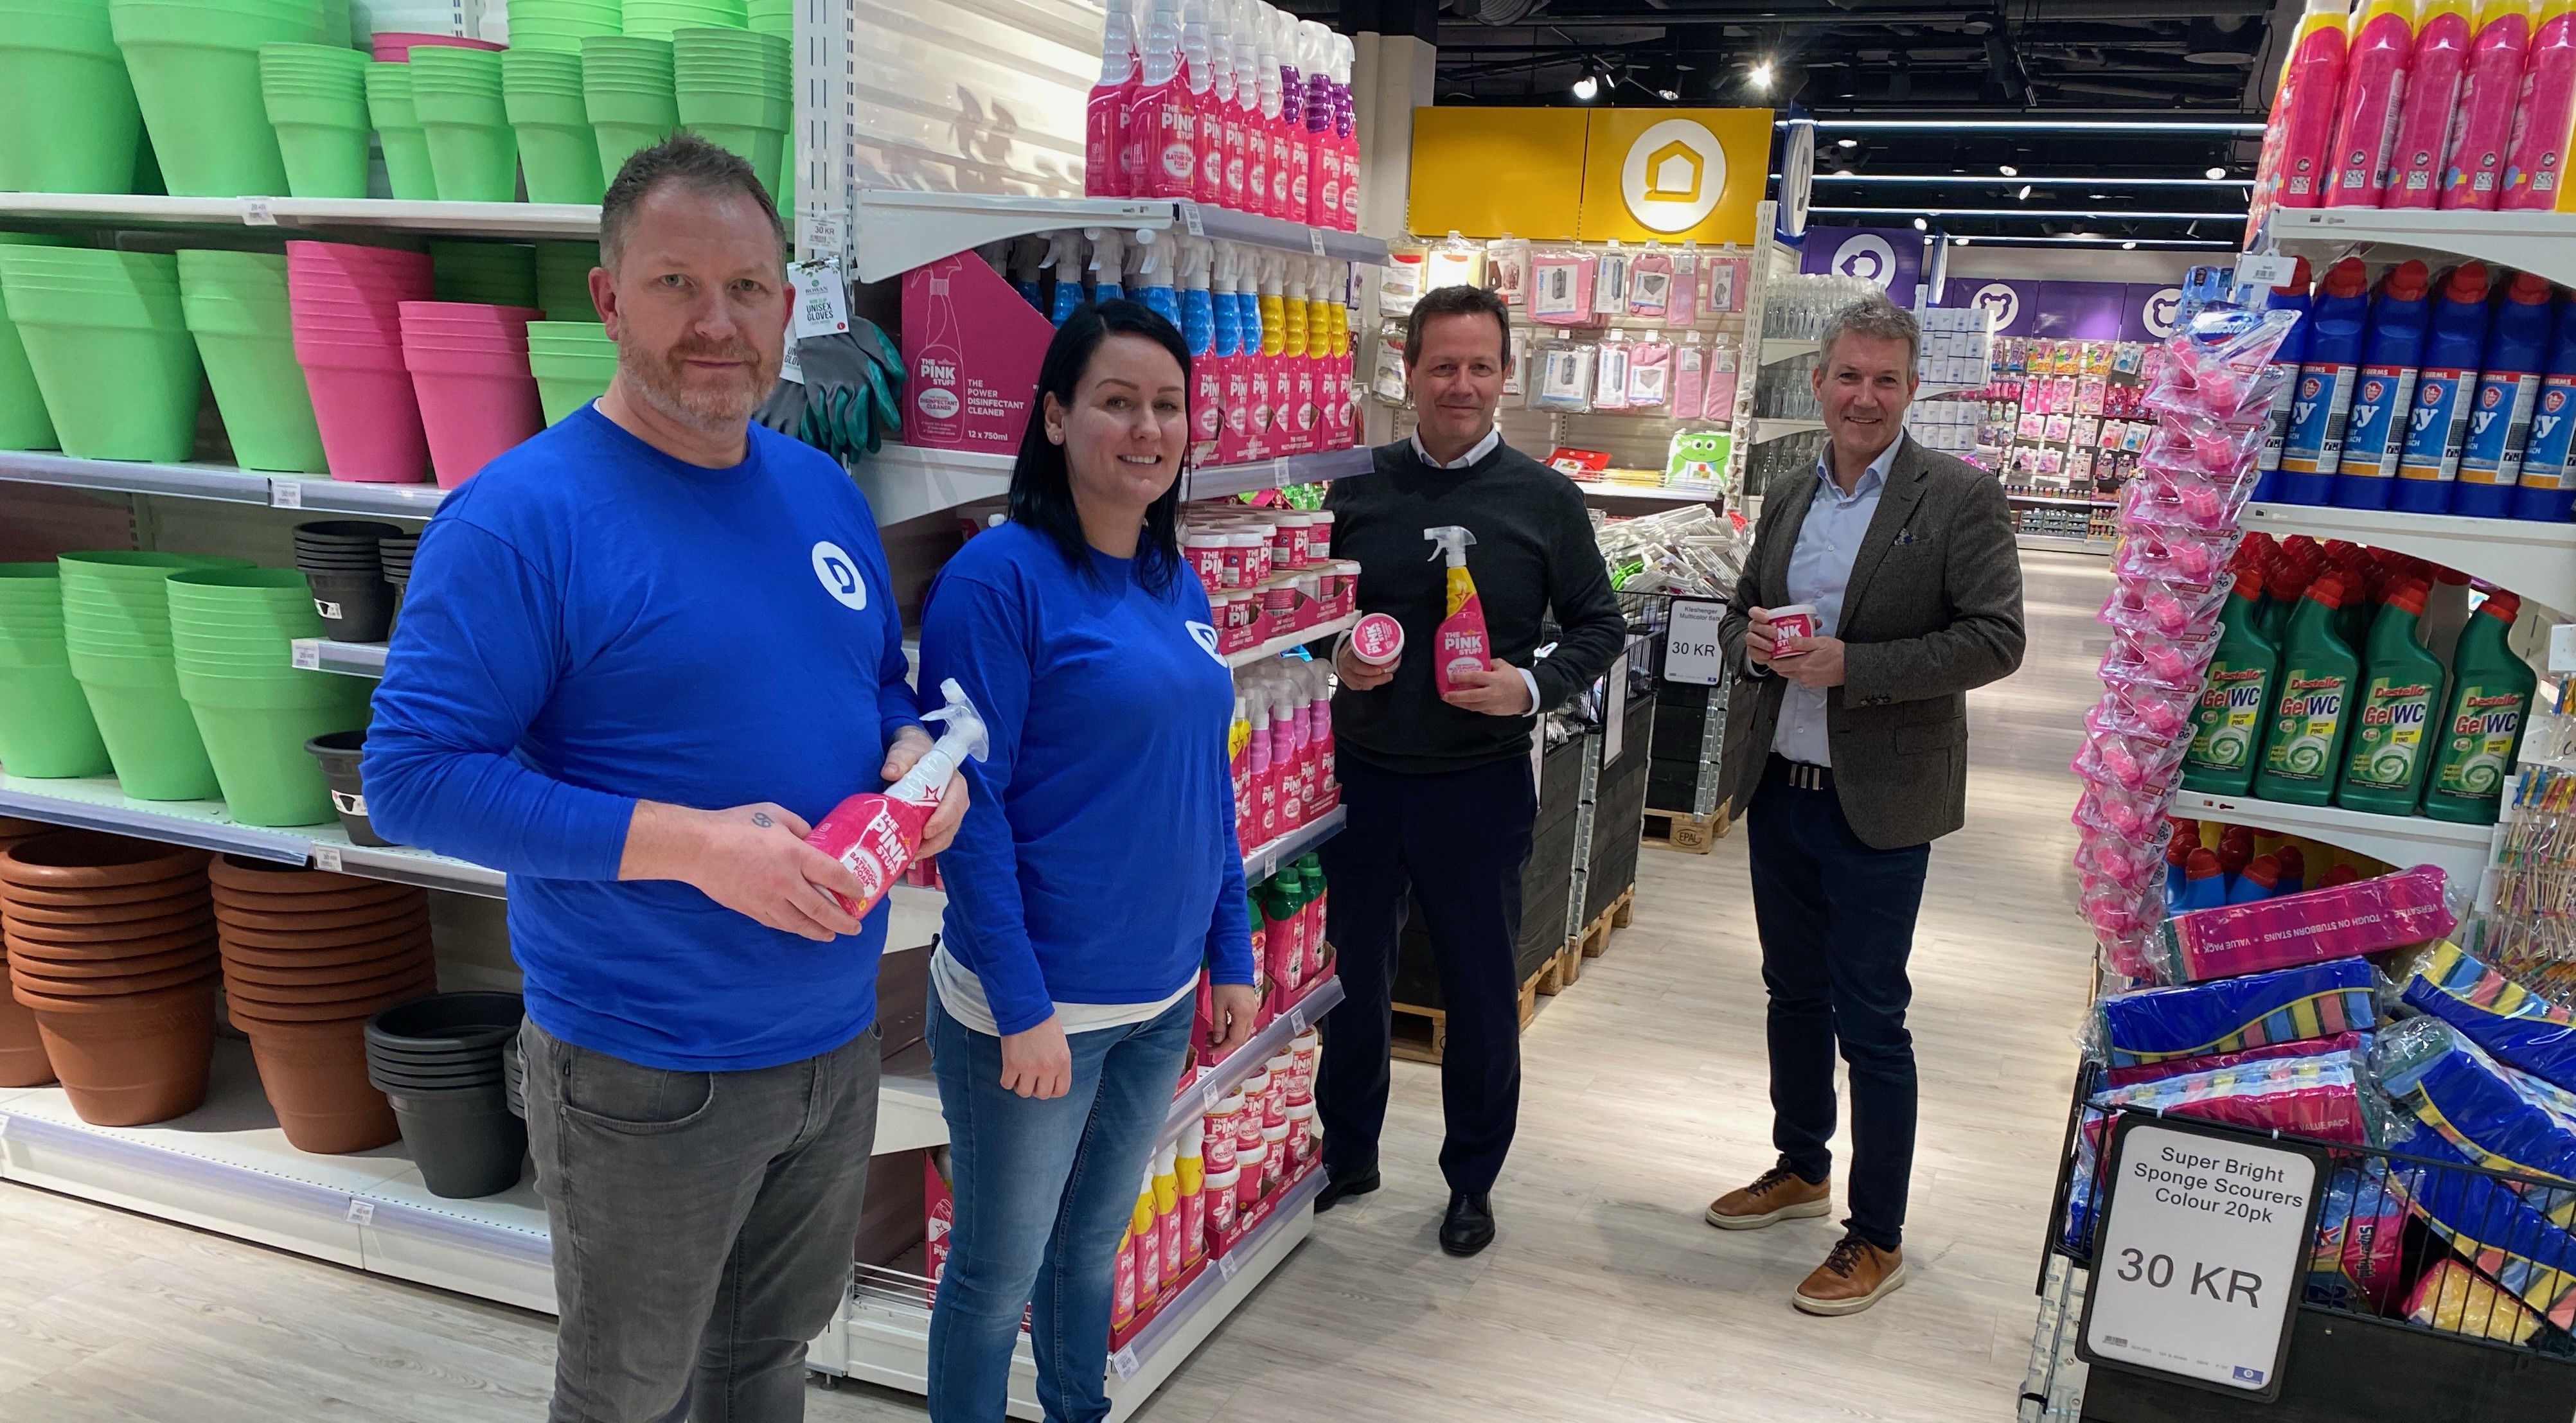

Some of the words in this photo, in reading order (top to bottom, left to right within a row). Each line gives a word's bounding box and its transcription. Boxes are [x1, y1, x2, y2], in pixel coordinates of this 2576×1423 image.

[1162, 103, 1180, 113] THE
[1162, 112, 1195, 132] PINK
[1204, 121, 1221, 139] PIN
[1226, 129, 1244, 146] PIN
[1250, 136, 1265, 154] PIN
[1273, 144, 1288, 160] PIN
[1292, 149, 1308, 168] PIN
[1323, 155, 1340, 172] PIN
[1343, 162, 1360, 177] PIN
[814, 225, 824, 234] 30
[824, 227, 835, 235] KR
[806, 302, 833, 314] UNISEX
[807, 310, 833, 321] GLOVES
[921, 358, 935, 366] THE
[920, 364, 955, 380] PINK
[933, 378, 955, 386] STUFF
[967, 378, 983, 388] THE
[1230, 382, 1247, 396] PIN
[1253, 380, 1268, 394] PIN
[967, 388, 998, 398] POWER
[1200, 382, 1220, 397] PIN
[919, 398, 957, 407] DISINFECTANT
[967, 398, 1024, 410] DISINFECTANT
[967, 407, 1004, 418] CLEANER
[968, 430, 977, 439] 12
[984, 431, 1008, 441] 750ml
[1202, 551, 1219, 560] THE
[1200, 559, 1223, 575] PIN
[1684, 606, 1718, 614] Kleshenger
[1229, 611, 1250, 627] PIN
[1777, 624, 1803, 641] NK
[1444, 635, 1482, 650] PINK
[1672, 641, 1689, 655] 30
[1694, 644, 1716, 657] KR
[2212, 668, 2261, 682] Destello
[2291, 676, 2341, 689] Destello
[2374, 684, 2425, 698] Destello
[2466, 693, 2519, 708] Destello
[1322, 755, 1335, 770] PIN
[1262, 790, 1275, 804] PIN
[882, 811, 900, 833] THE
[1679, 832, 1698, 842] EPAL
[867, 817, 908, 872] PINK
[875, 845, 896, 876] STUFF
[853, 866, 870, 887] FOAM
[2338, 919, 2351, 928] ON
[2352, 915, 2381, 926] TOUGH
[2293, 921, 2337, 936] STUBBORN
[2264, 930, 2292, 942] STAINS
[2203, 942, 2225, 953] PACK
[2226, 938, 2251, 950] VALUE
[2298, 1118, 2327, 1131] VALUE
[2327, 1117, 2351, 1129] PACK
[2161, 1146, 2221, 1171] Super
[2225, 1159, 2286, 1183] Bright
[2134, 1163, 2208, 1190] Sponge
[2214, 1178, 2304, 1208] Scourers
[2155, 1188, 2221, 1213] Colour
[2224, 1201, 2274, 1224] 20pk
[934, 1248, 948, 1257] PIN
[2117, 1248, 2174, 1288] 30
[2190, 1262, 2263, 1309] KR
